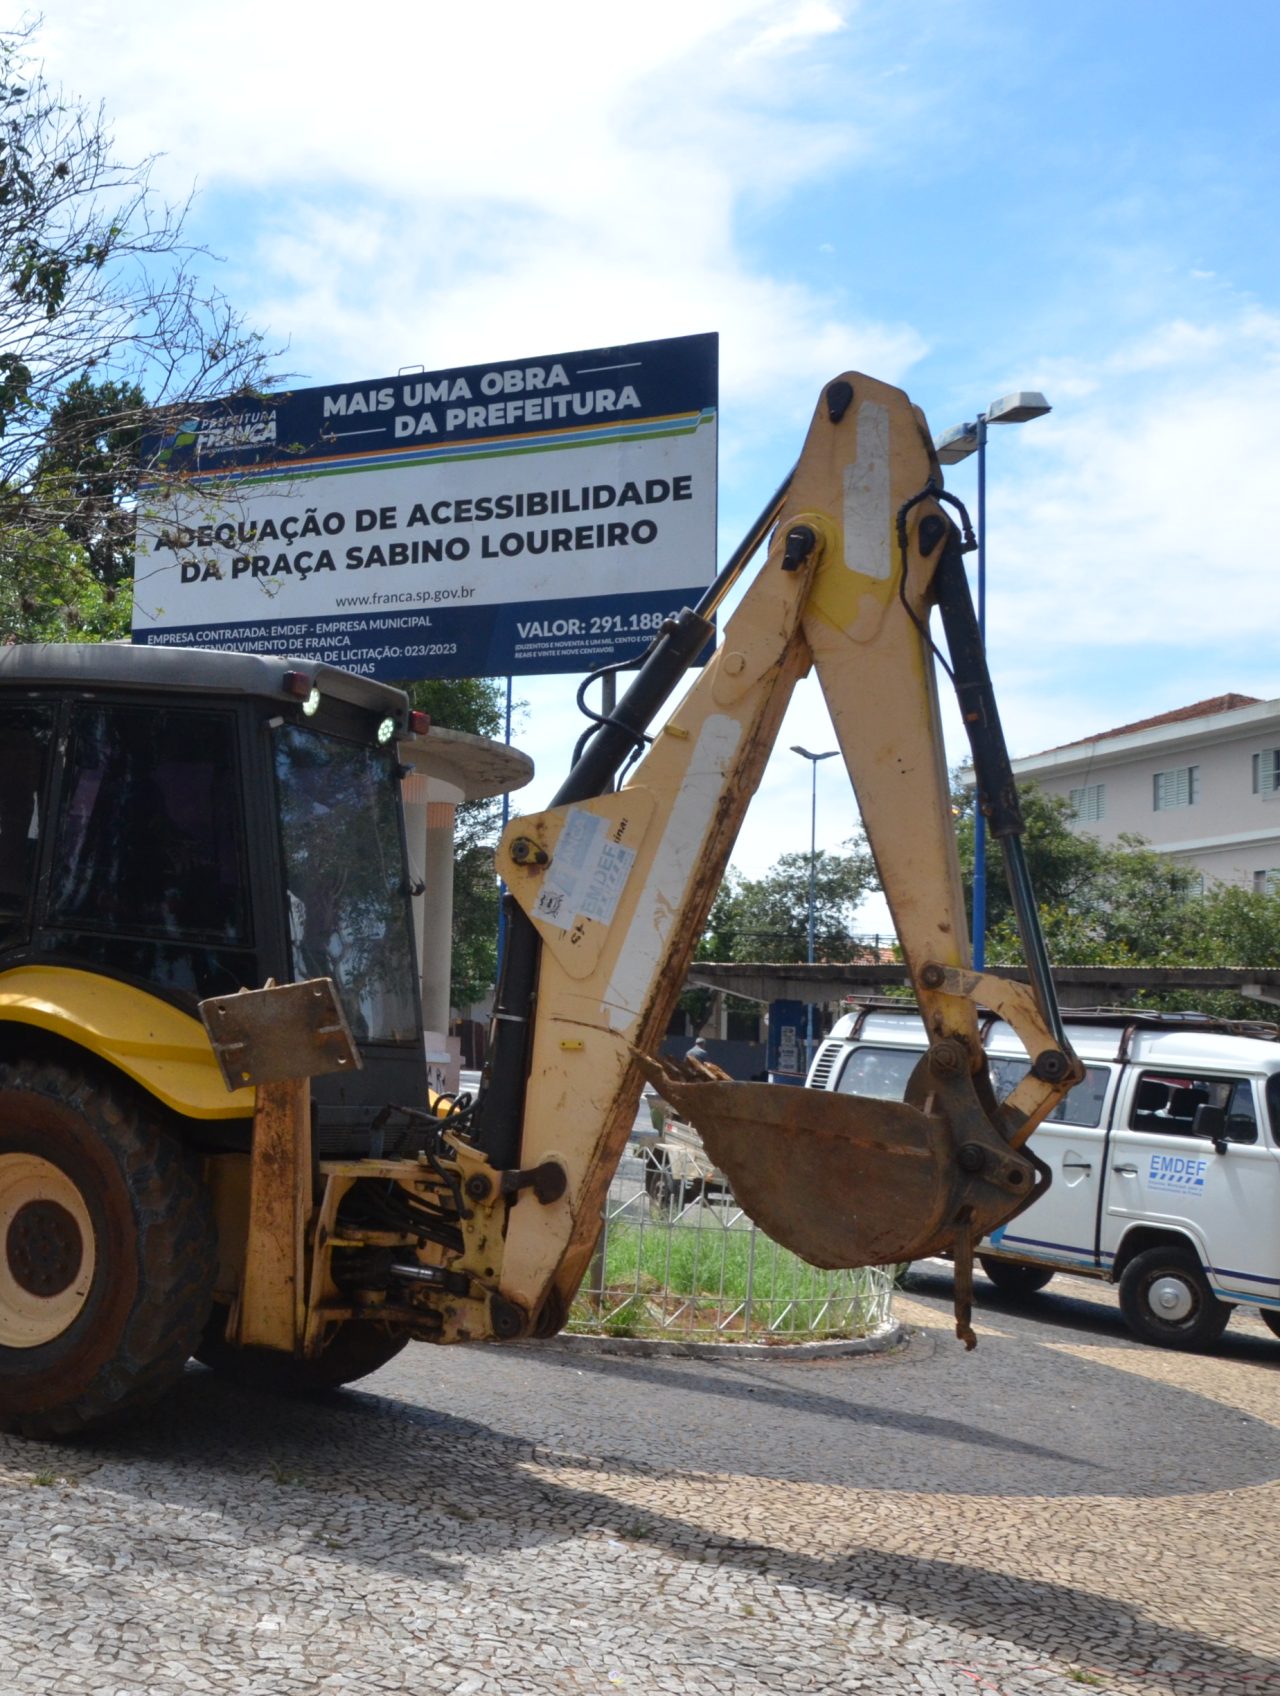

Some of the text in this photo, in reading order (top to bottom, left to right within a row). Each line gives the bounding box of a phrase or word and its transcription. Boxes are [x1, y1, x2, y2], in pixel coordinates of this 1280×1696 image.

[323, 364, 569, 417] MAIS UMA OBRA
[395, 385, 641, 438] DA PREFEITURA
[154, 475, 692, 551] ADEQUAÇÃO DE ACESSIBILIDADE
[181, 519, 658, 583] DA PRAÇA SABINO LOUREIRO
[335, 586, 475, 607] www.franca.sp.gov.br
[147, 632, 194, 645] EMPRESA
[196, 627, 269, 642] CONTRATADA:
[271, 624, 308, 636] EMDEF
[316, 620, 367, 634] EMPRESA
[370, 616, 432, 630] MUNICIPAL
[517, 619, 586, 638] VALOR:
[289, 639, 303, 649] DE
[305, 636, 351, 648] FRANCA
[324, 651, 339, 661] DE
[341, 645, 403, 661] LICITAÇÃO:
[404, 643, 457, 656] 023/2023
[349, 663, 375, 674] DIAS
[1150, 1155, 1207, 1176] EMDEF
